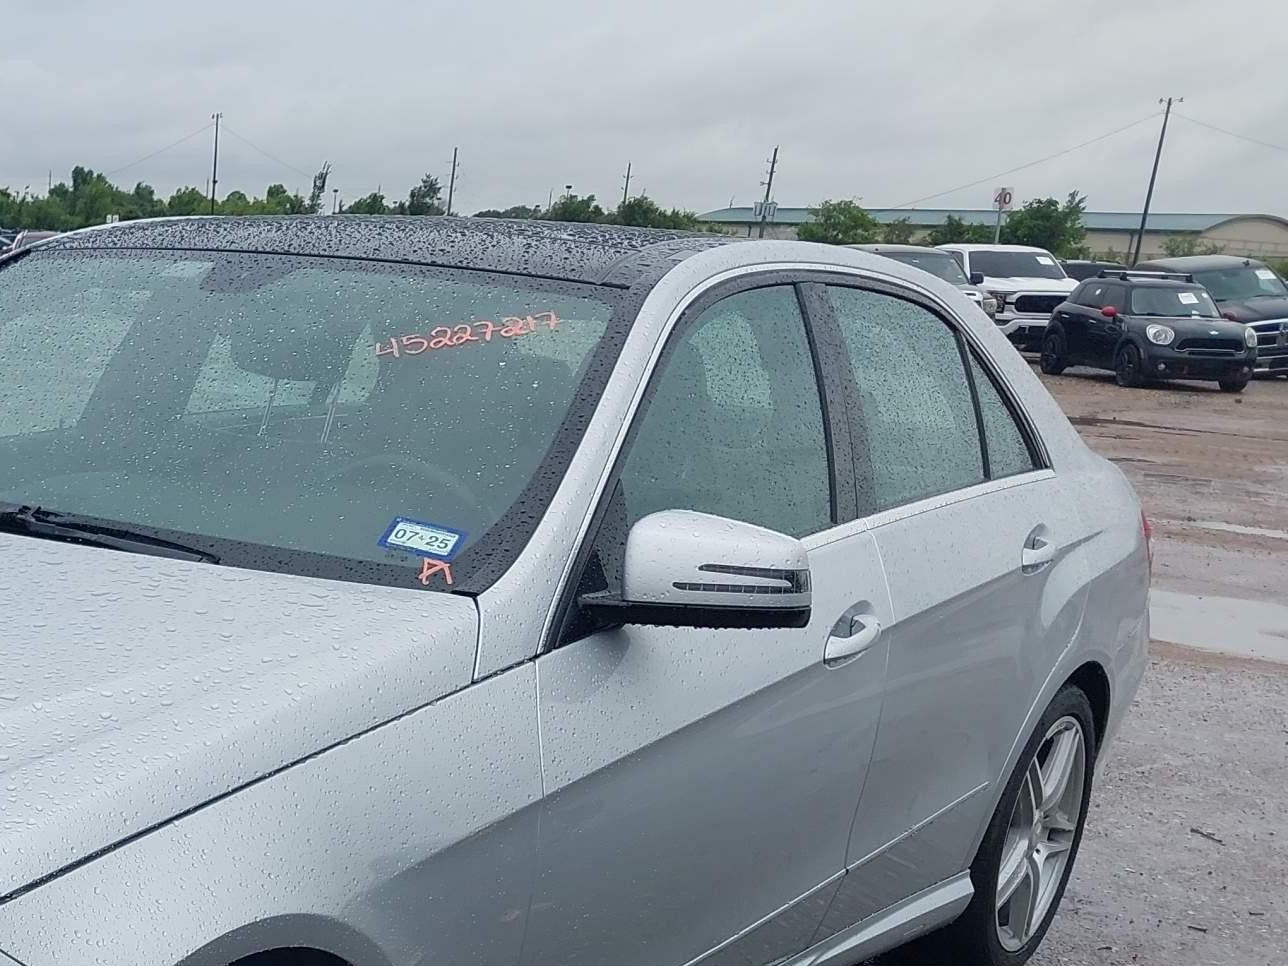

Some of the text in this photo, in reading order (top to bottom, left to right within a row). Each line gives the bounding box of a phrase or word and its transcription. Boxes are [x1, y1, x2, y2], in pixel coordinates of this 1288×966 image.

[375, 309, 560, 358] 45227217
[394, 528, 420, 542] 07
[425, 535, 451, 550] 25
